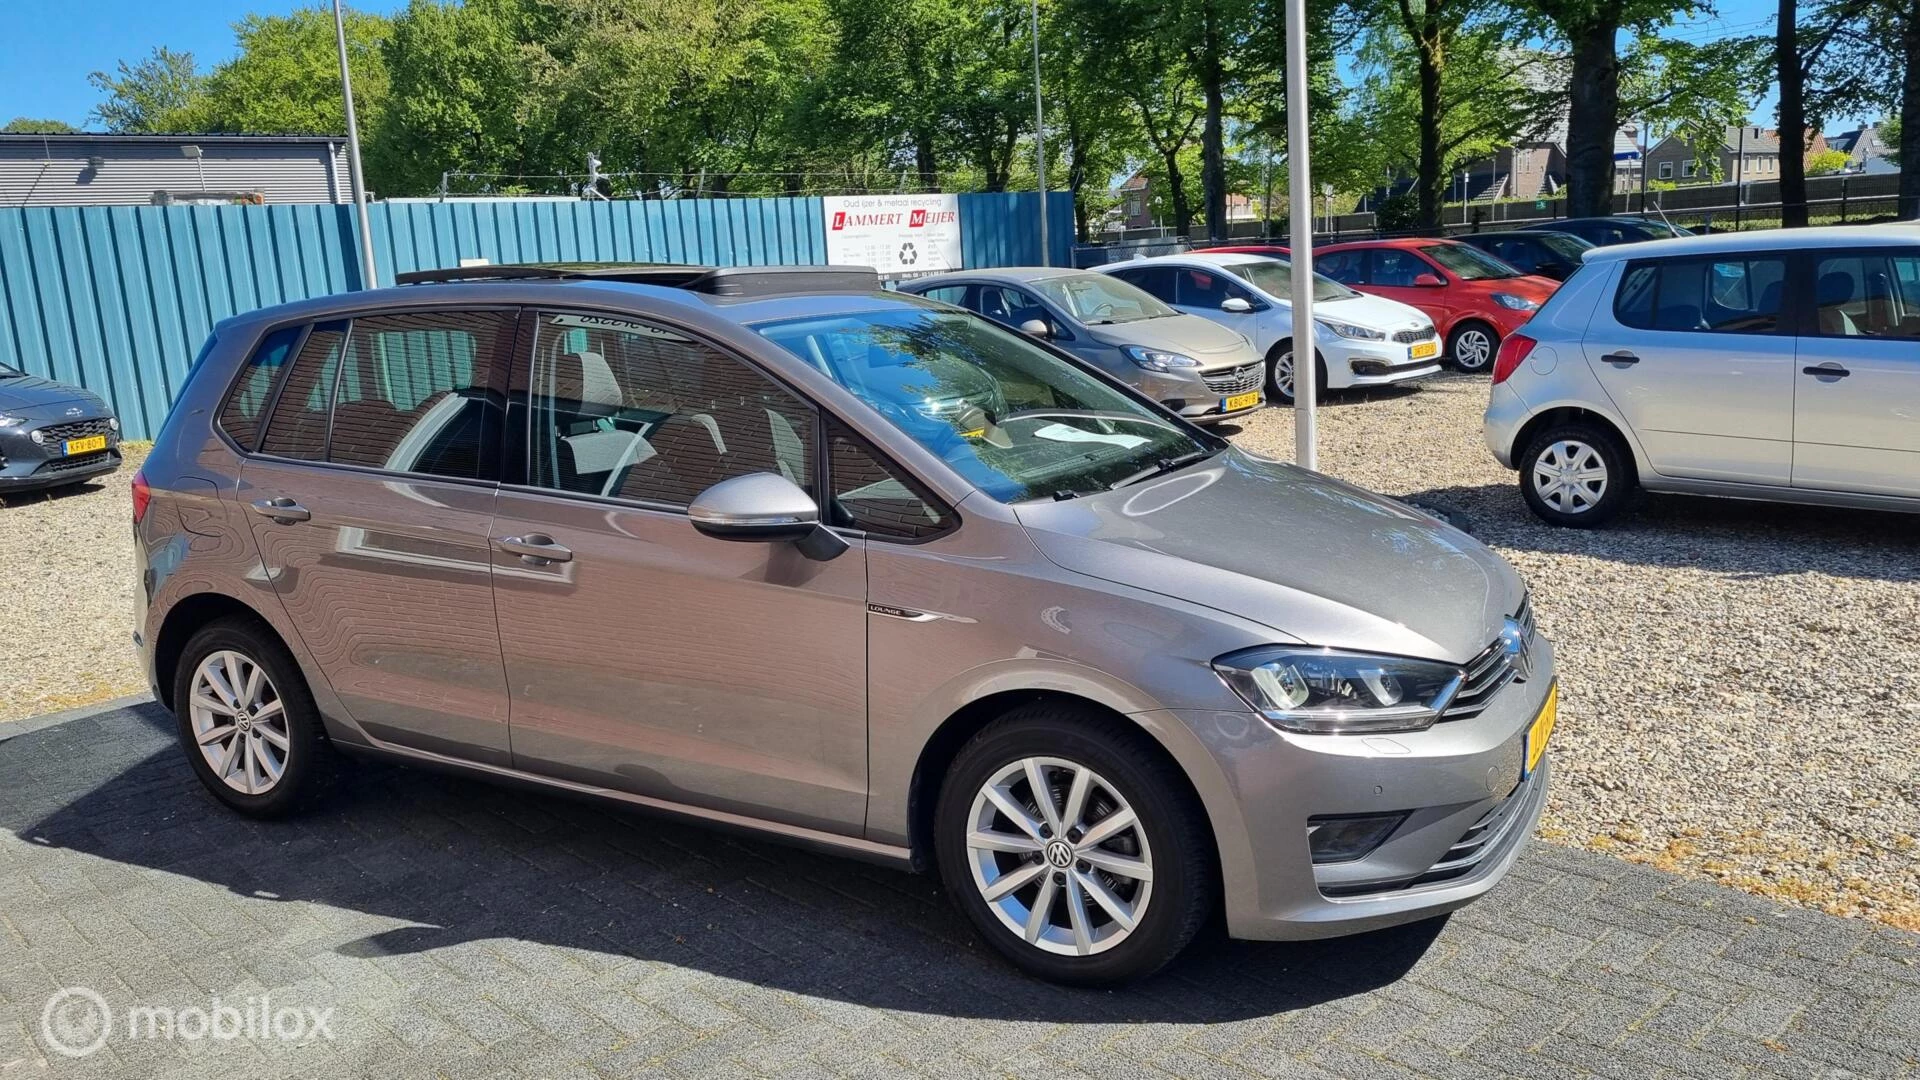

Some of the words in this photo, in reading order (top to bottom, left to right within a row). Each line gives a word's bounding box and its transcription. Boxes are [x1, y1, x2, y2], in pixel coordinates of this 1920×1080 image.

[843, 199, 860, 208] Oud
[862, 200, 875, 209] ijzer
[885, 199, 909, 207] metaal
[911, 198, 942, 208] recycling
[833, 212, 903, 229] LAMMERT
[909, 210, 955, 227] MEIJER
[70, 437, 103, 452] KFV-80-T
[870, 605, 902, 616] LOUNGE
